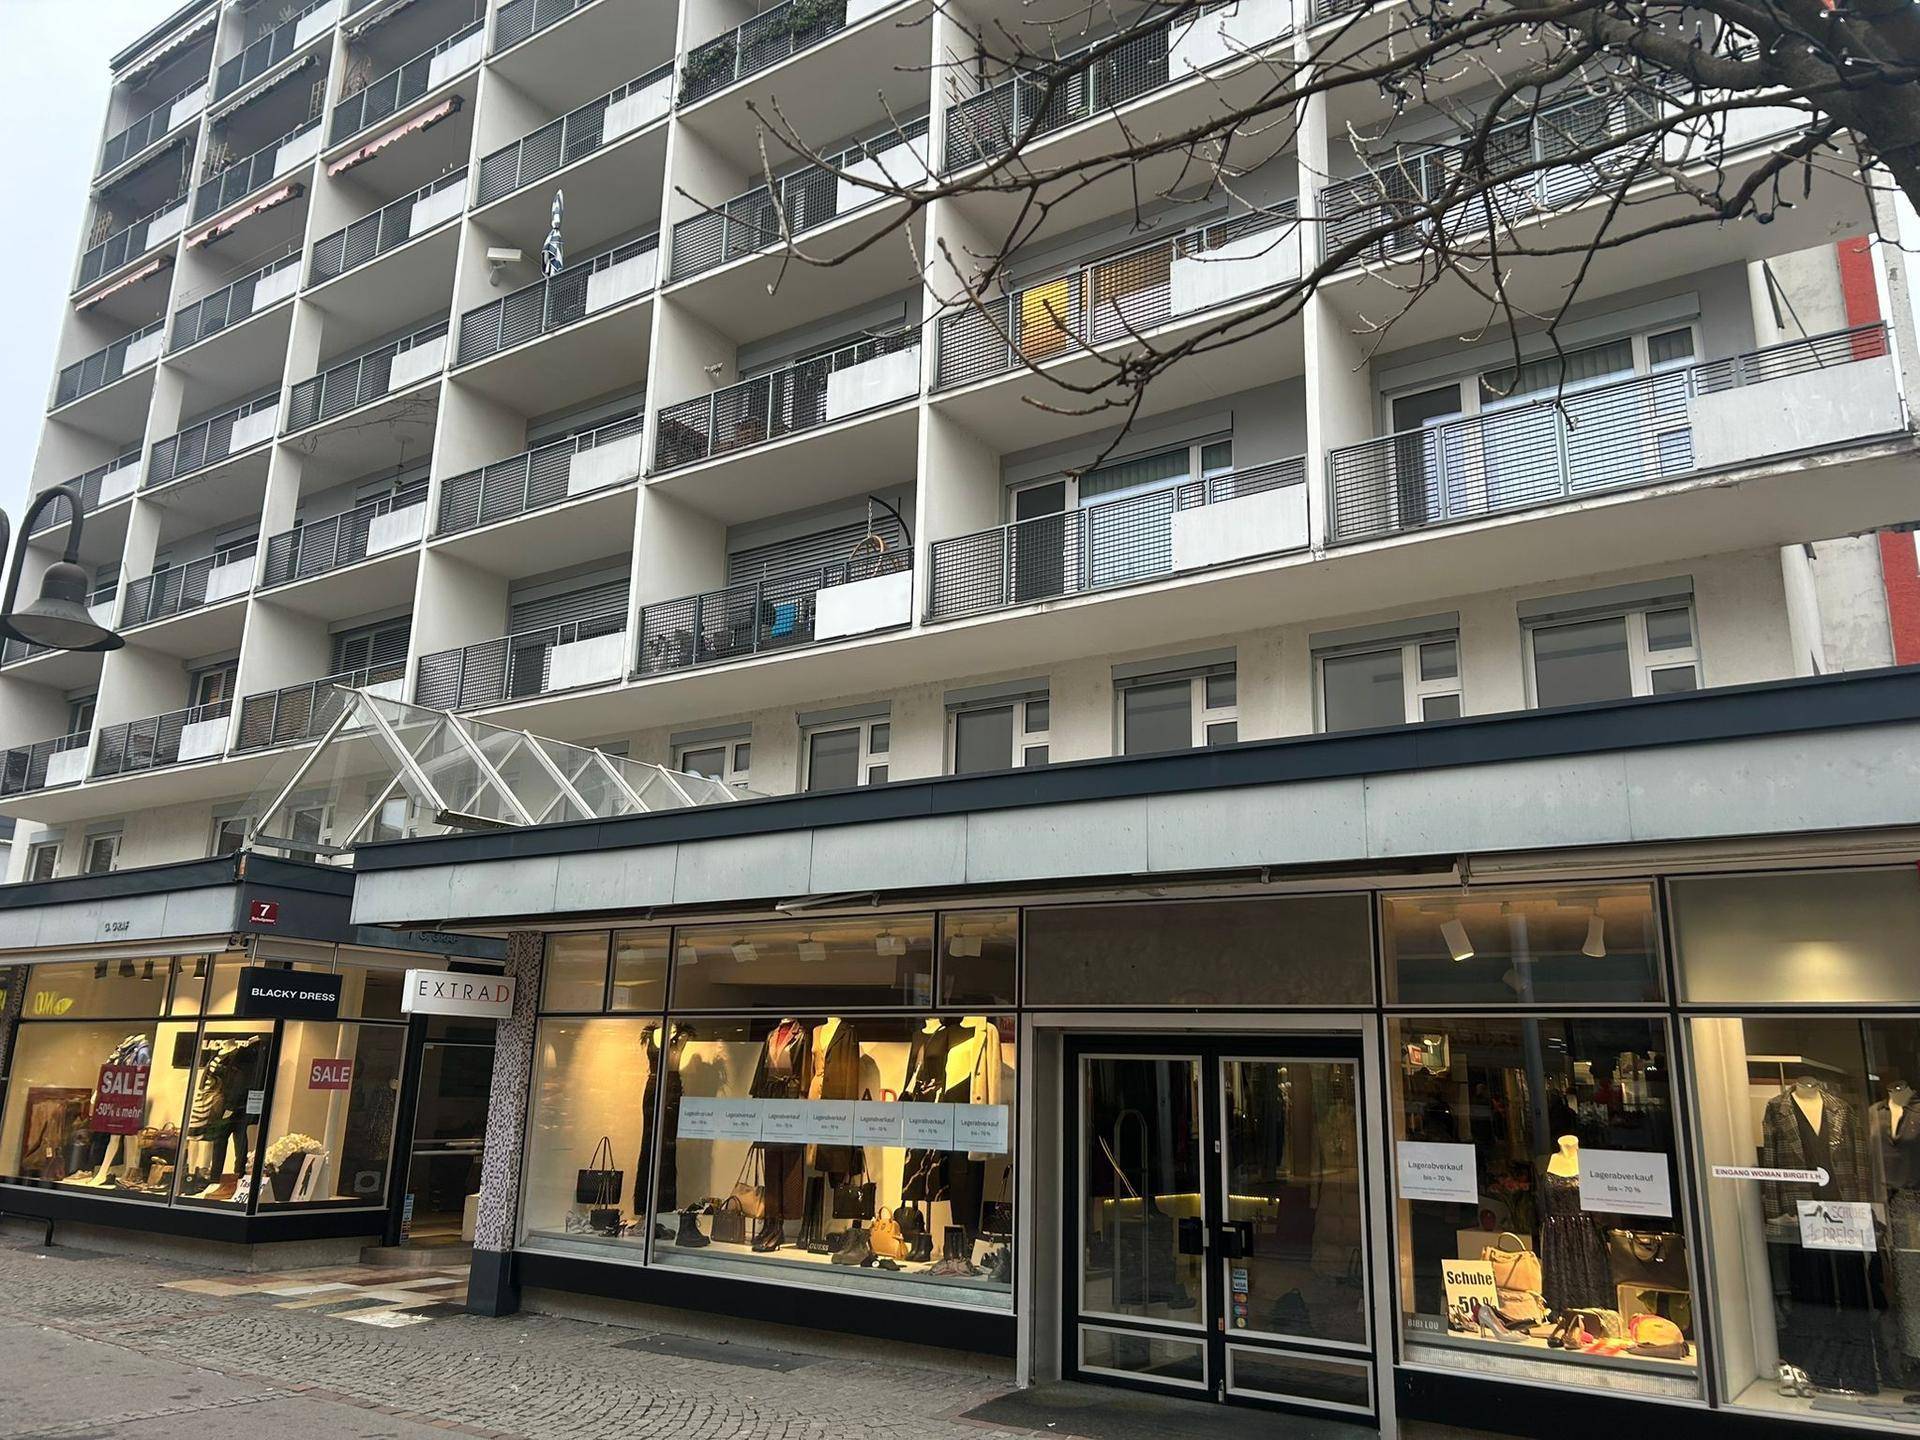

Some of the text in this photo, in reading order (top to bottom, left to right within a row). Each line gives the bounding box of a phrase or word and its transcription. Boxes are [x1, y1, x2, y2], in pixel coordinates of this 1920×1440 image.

[260, 904, 271, 917] 7
[251, 988, 336, 1002] BLACKY DRESS
[419, 980, 510, 1003] EXTRAD
[312, 1065, 351, 1082] SALE
[101, 1071, 146, 1096] SALE
[121, 1105, 143, 1118] mehr
[1408, 1161, 1464, 1170] Lagerabverkauf
[1590, 1170, 1654, 1182] Lagerabverkauf
[1715, 1168, 1750, 1176] EINGANG
[1751, 1170, 1781, 1178] WOMAN
[1783, 1171, 1809, 1179] BIRGIT
[1446, 1271, 1493, 1285] Schuhe
